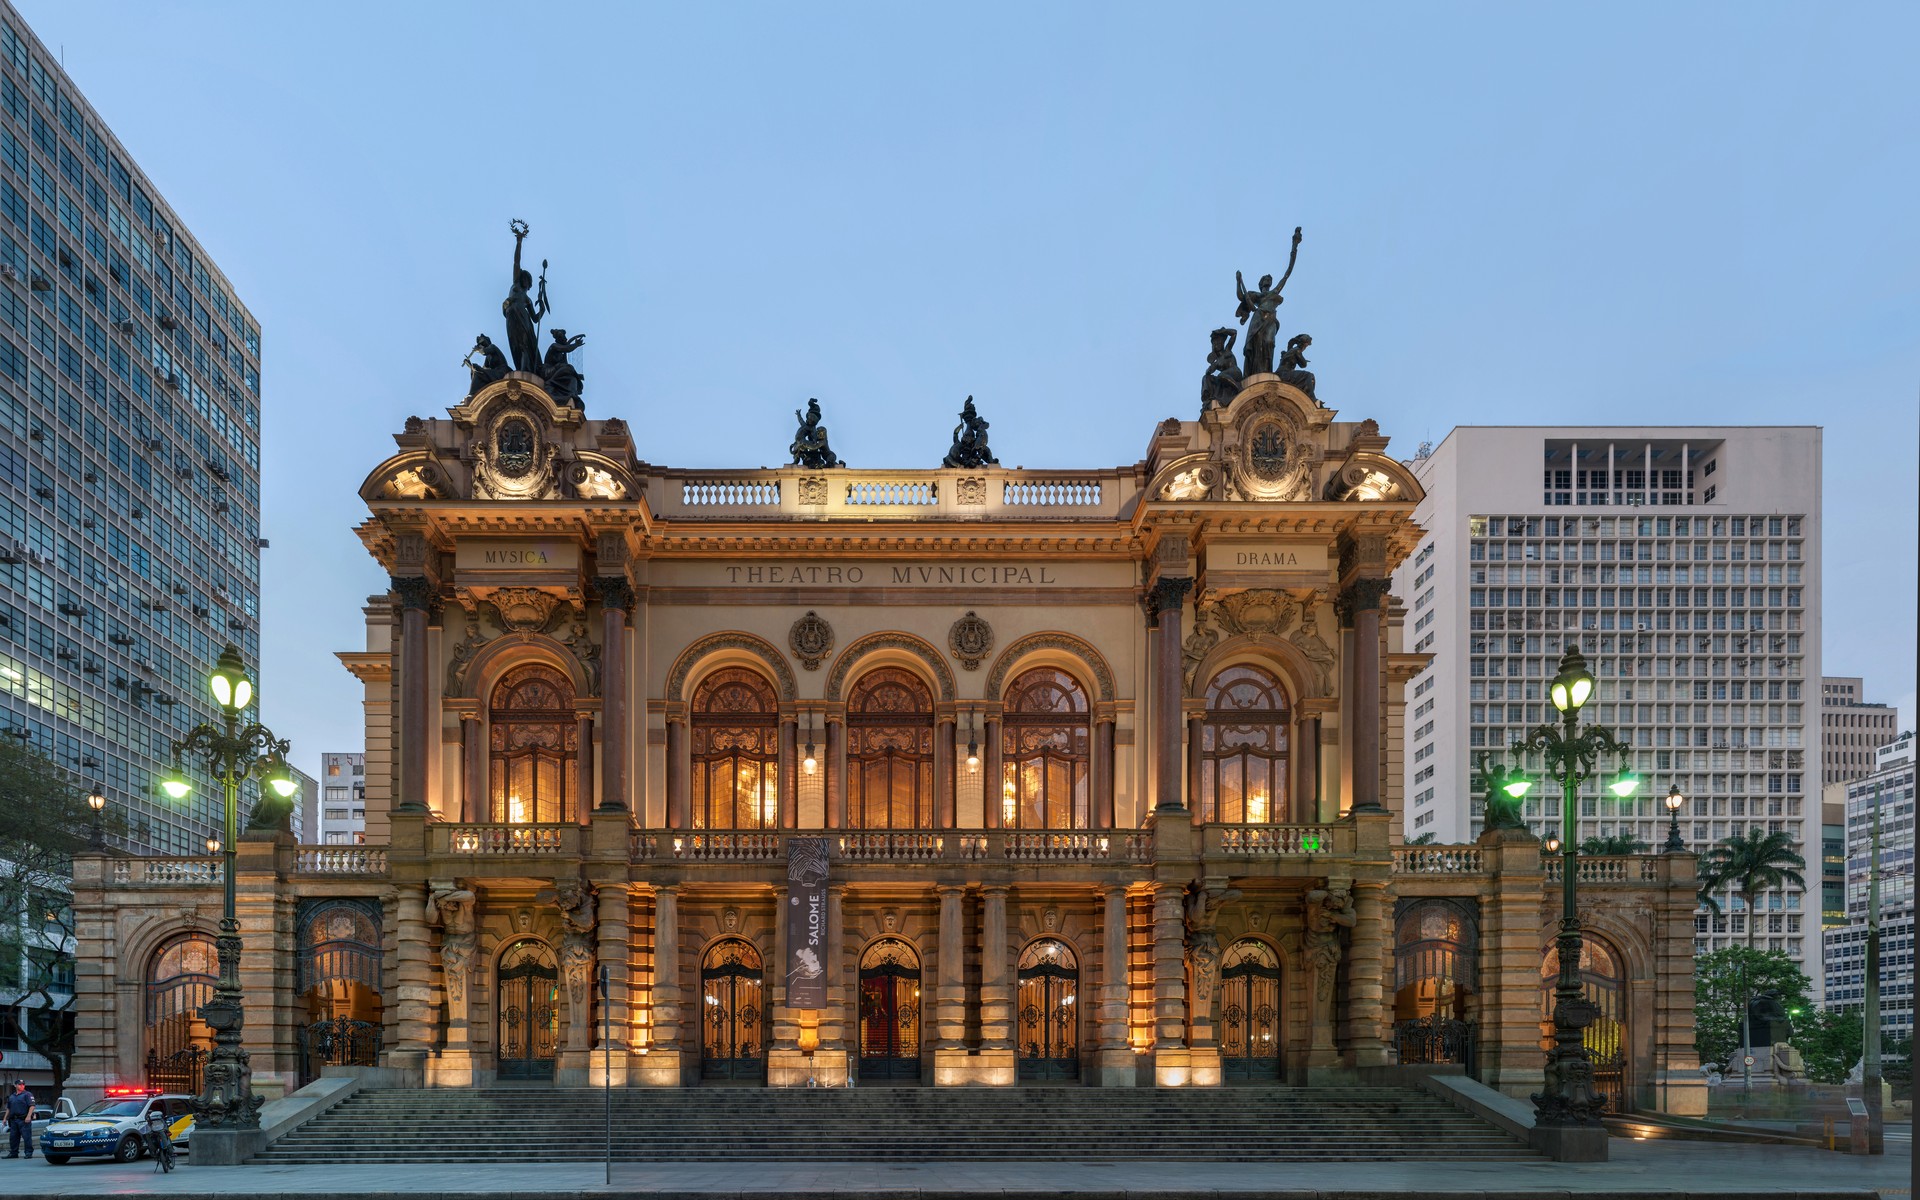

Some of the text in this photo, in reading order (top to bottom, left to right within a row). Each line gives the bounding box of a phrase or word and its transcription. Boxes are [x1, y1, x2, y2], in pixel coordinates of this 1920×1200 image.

[485, 550, 548, 564] MVSICA
[1236, 552, 1298, 565] DRAMA
[725, 566, 1056, 584] THEATRO MVNICIPAL
[808, 895, 819, 946] SALOME
